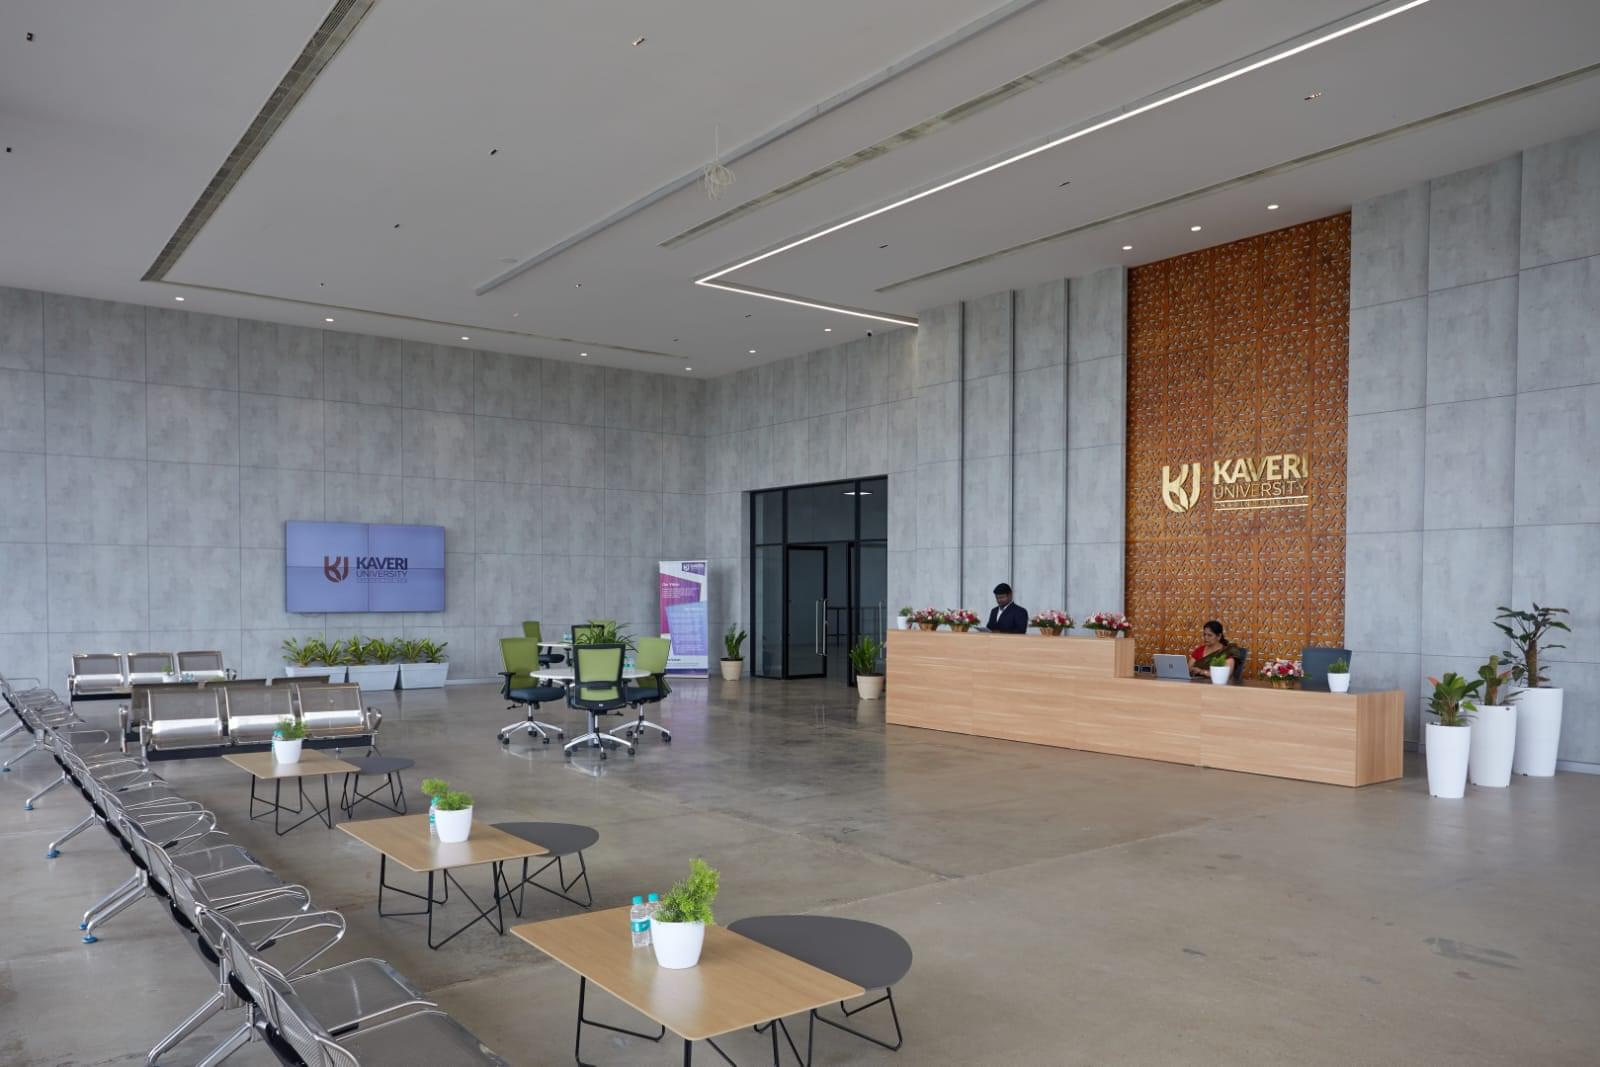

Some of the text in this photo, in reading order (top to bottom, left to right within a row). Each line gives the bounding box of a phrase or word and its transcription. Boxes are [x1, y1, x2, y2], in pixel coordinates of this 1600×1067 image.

[1213, 452, 1309, 485] KAVERI
[1213, 480, 1308, 500] UNIVERSITY
[356, 556, 408, 570] KAVERI
[356, 570, 408, 578] UNIVERSITY
